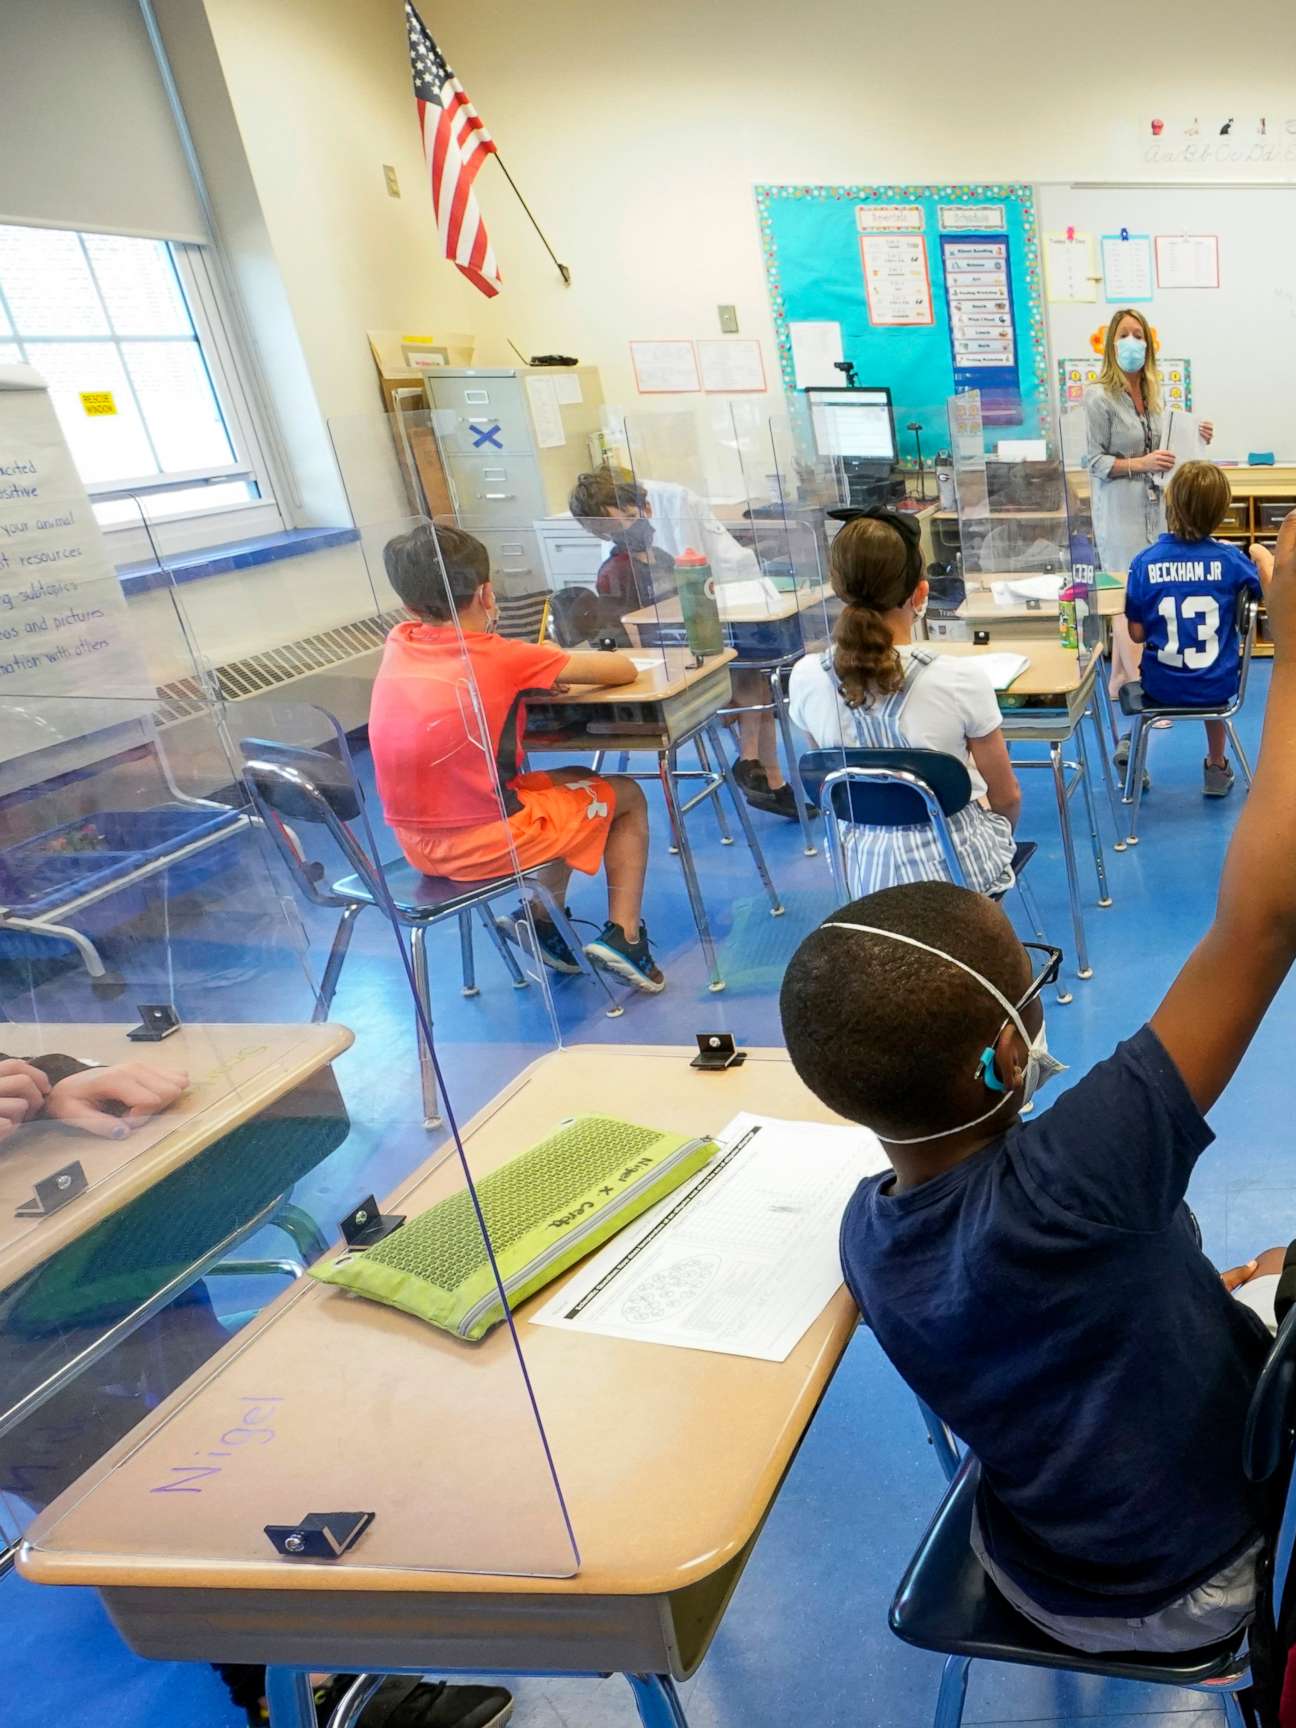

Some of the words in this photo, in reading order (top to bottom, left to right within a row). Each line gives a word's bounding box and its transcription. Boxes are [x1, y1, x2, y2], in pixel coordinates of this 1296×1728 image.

[36, 511, 75, 530] animal
[20, 548, 82, 567] resources
[1148, 561, 1205, 584] BECKHAM
[1206, 561, 1222, 581] JR
[25, 616, 49, 634] and
[53, 608, 105, 632] pictures
[1157, 596, 1221, 670] 13
[618, 1157, 654, 1183] Nigel
[548, 1201, 595, 1228] Cerda
[150, 1396, 286, 1494] Nigel
